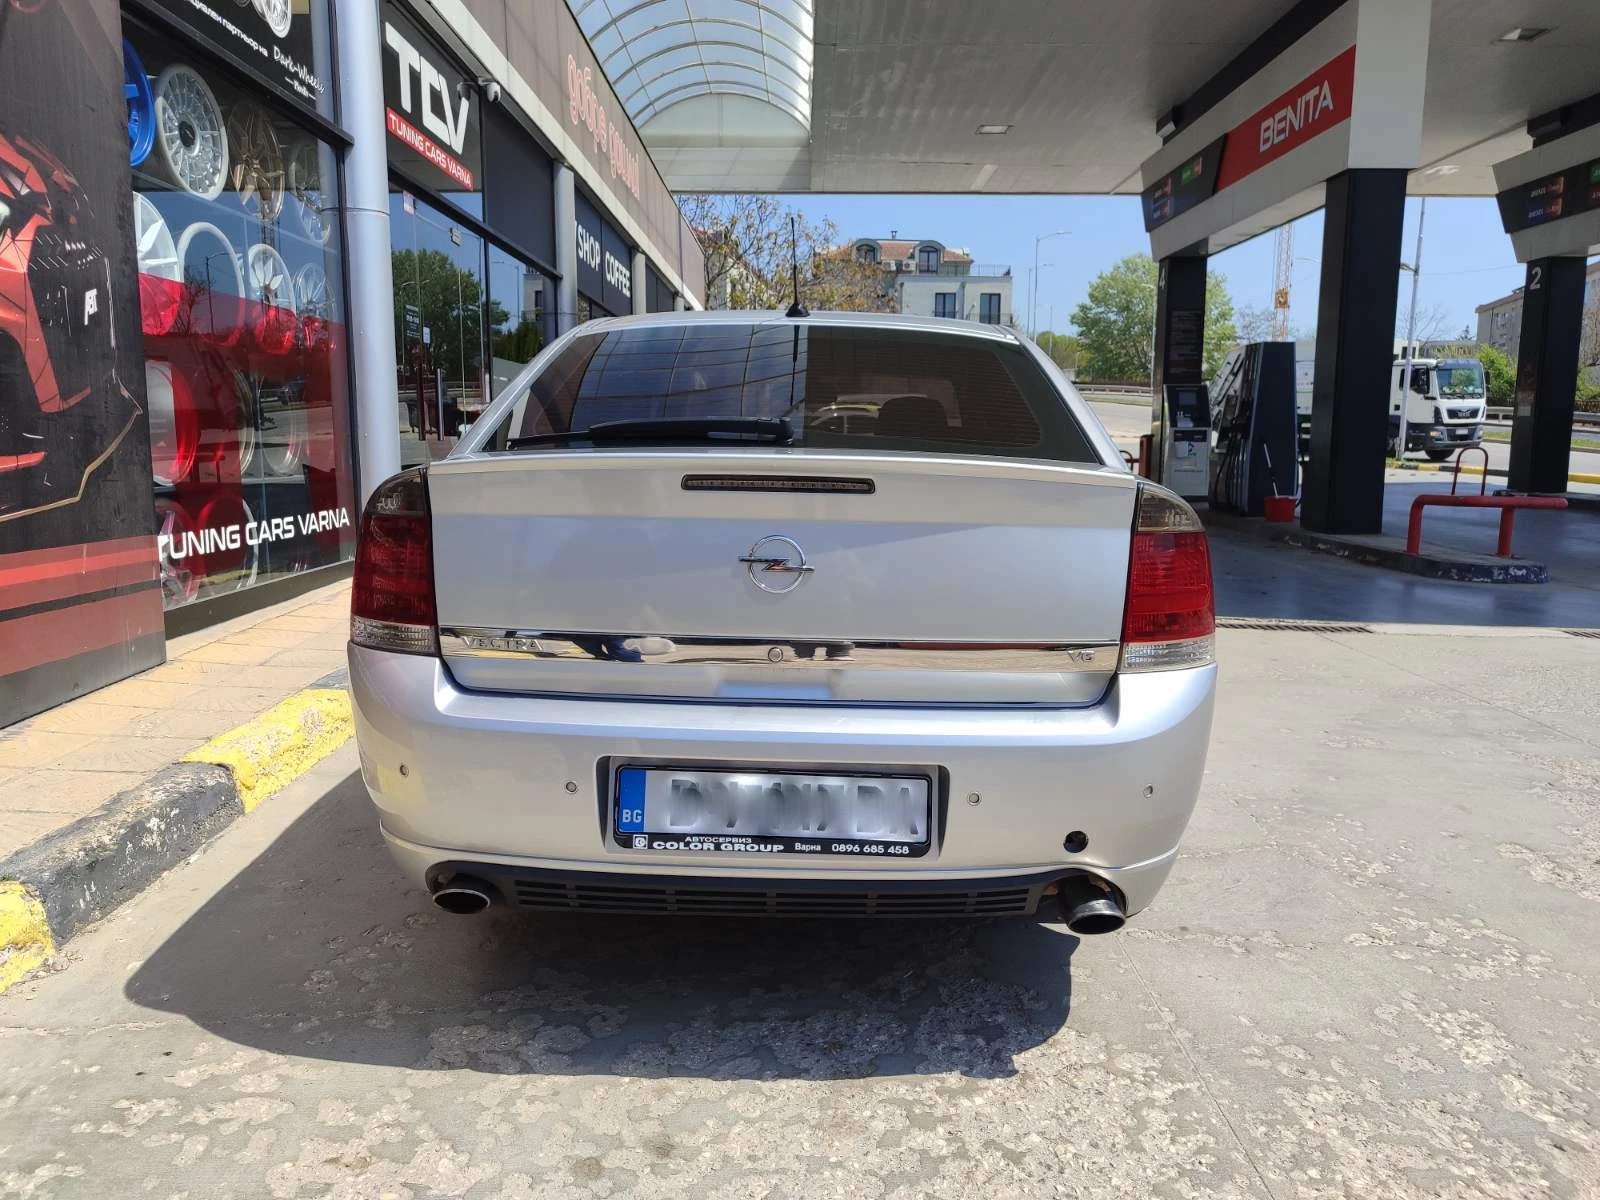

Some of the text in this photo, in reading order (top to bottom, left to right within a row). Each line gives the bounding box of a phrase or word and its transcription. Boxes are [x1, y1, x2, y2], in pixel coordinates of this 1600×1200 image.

[222, 18, 259, 51] партньор
[385, 21, 469, 155] TCV
[1260, 80, 1334, 153] BENITA
[389, 112, 472, 186] TUNING CARS VARNA
[577, 224, 631, 298] SHOP COFFEE
[1529, 266, 1542, 290] 2
[245, 516, 295, 546] CARS
[297, 507, 350, 536] VARNA
[460, 635, 544, 652] VECTRA
[1067, 650, 1095, 664] V6
[622, 809, 642, 823] BG
[653, 841, 784, 853] COLOR GROUP
[685, 836, 752, 844] АВТОСЕРВИЗ
[794, 842, 821, 852] Варна
[831, 843, 910, 855] 0896 685 458
